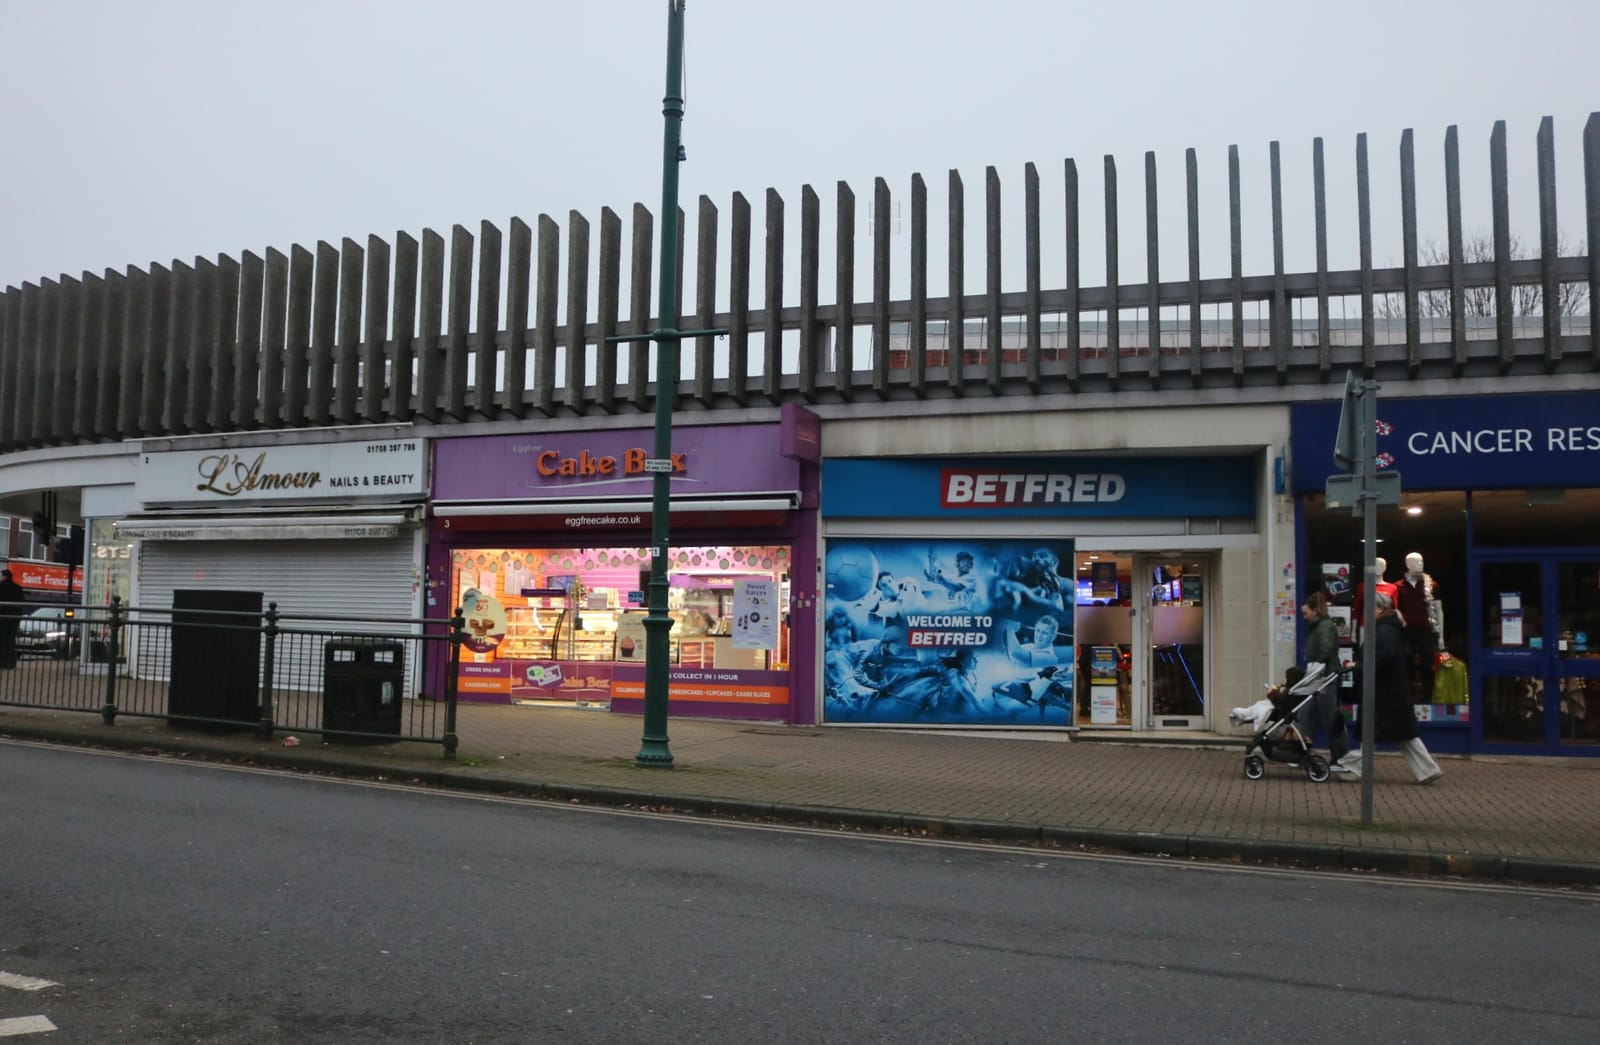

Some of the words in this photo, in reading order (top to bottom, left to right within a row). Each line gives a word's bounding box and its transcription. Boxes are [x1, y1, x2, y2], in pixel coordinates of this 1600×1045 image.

[1408, 428, 1533, 454] CANCER
[1548, 426, 1600, 451] RES
[536, 450, 617, 476] Cake
[624, 447, 687, 473] Bx
[197, 451, 321, 496] L'Amour
[330, 476, 359, 487] NAILS
[363, 475, 369, 486] &
[373, 474, 414, 485] BEAUTY
[947, 474, 1126, 503] BETFRED
[444, 519, 450, 528] 3
[565, 515, 641, 527] eggfreecake.co.uk
[22, 572, 42, 585] Saint
[44, 575, 69, 587] Franci
[907, 615, 972, 628] WELCOME
[974, 615, 993, 628] TO
[911, 631, 987, 646] BETFRED
